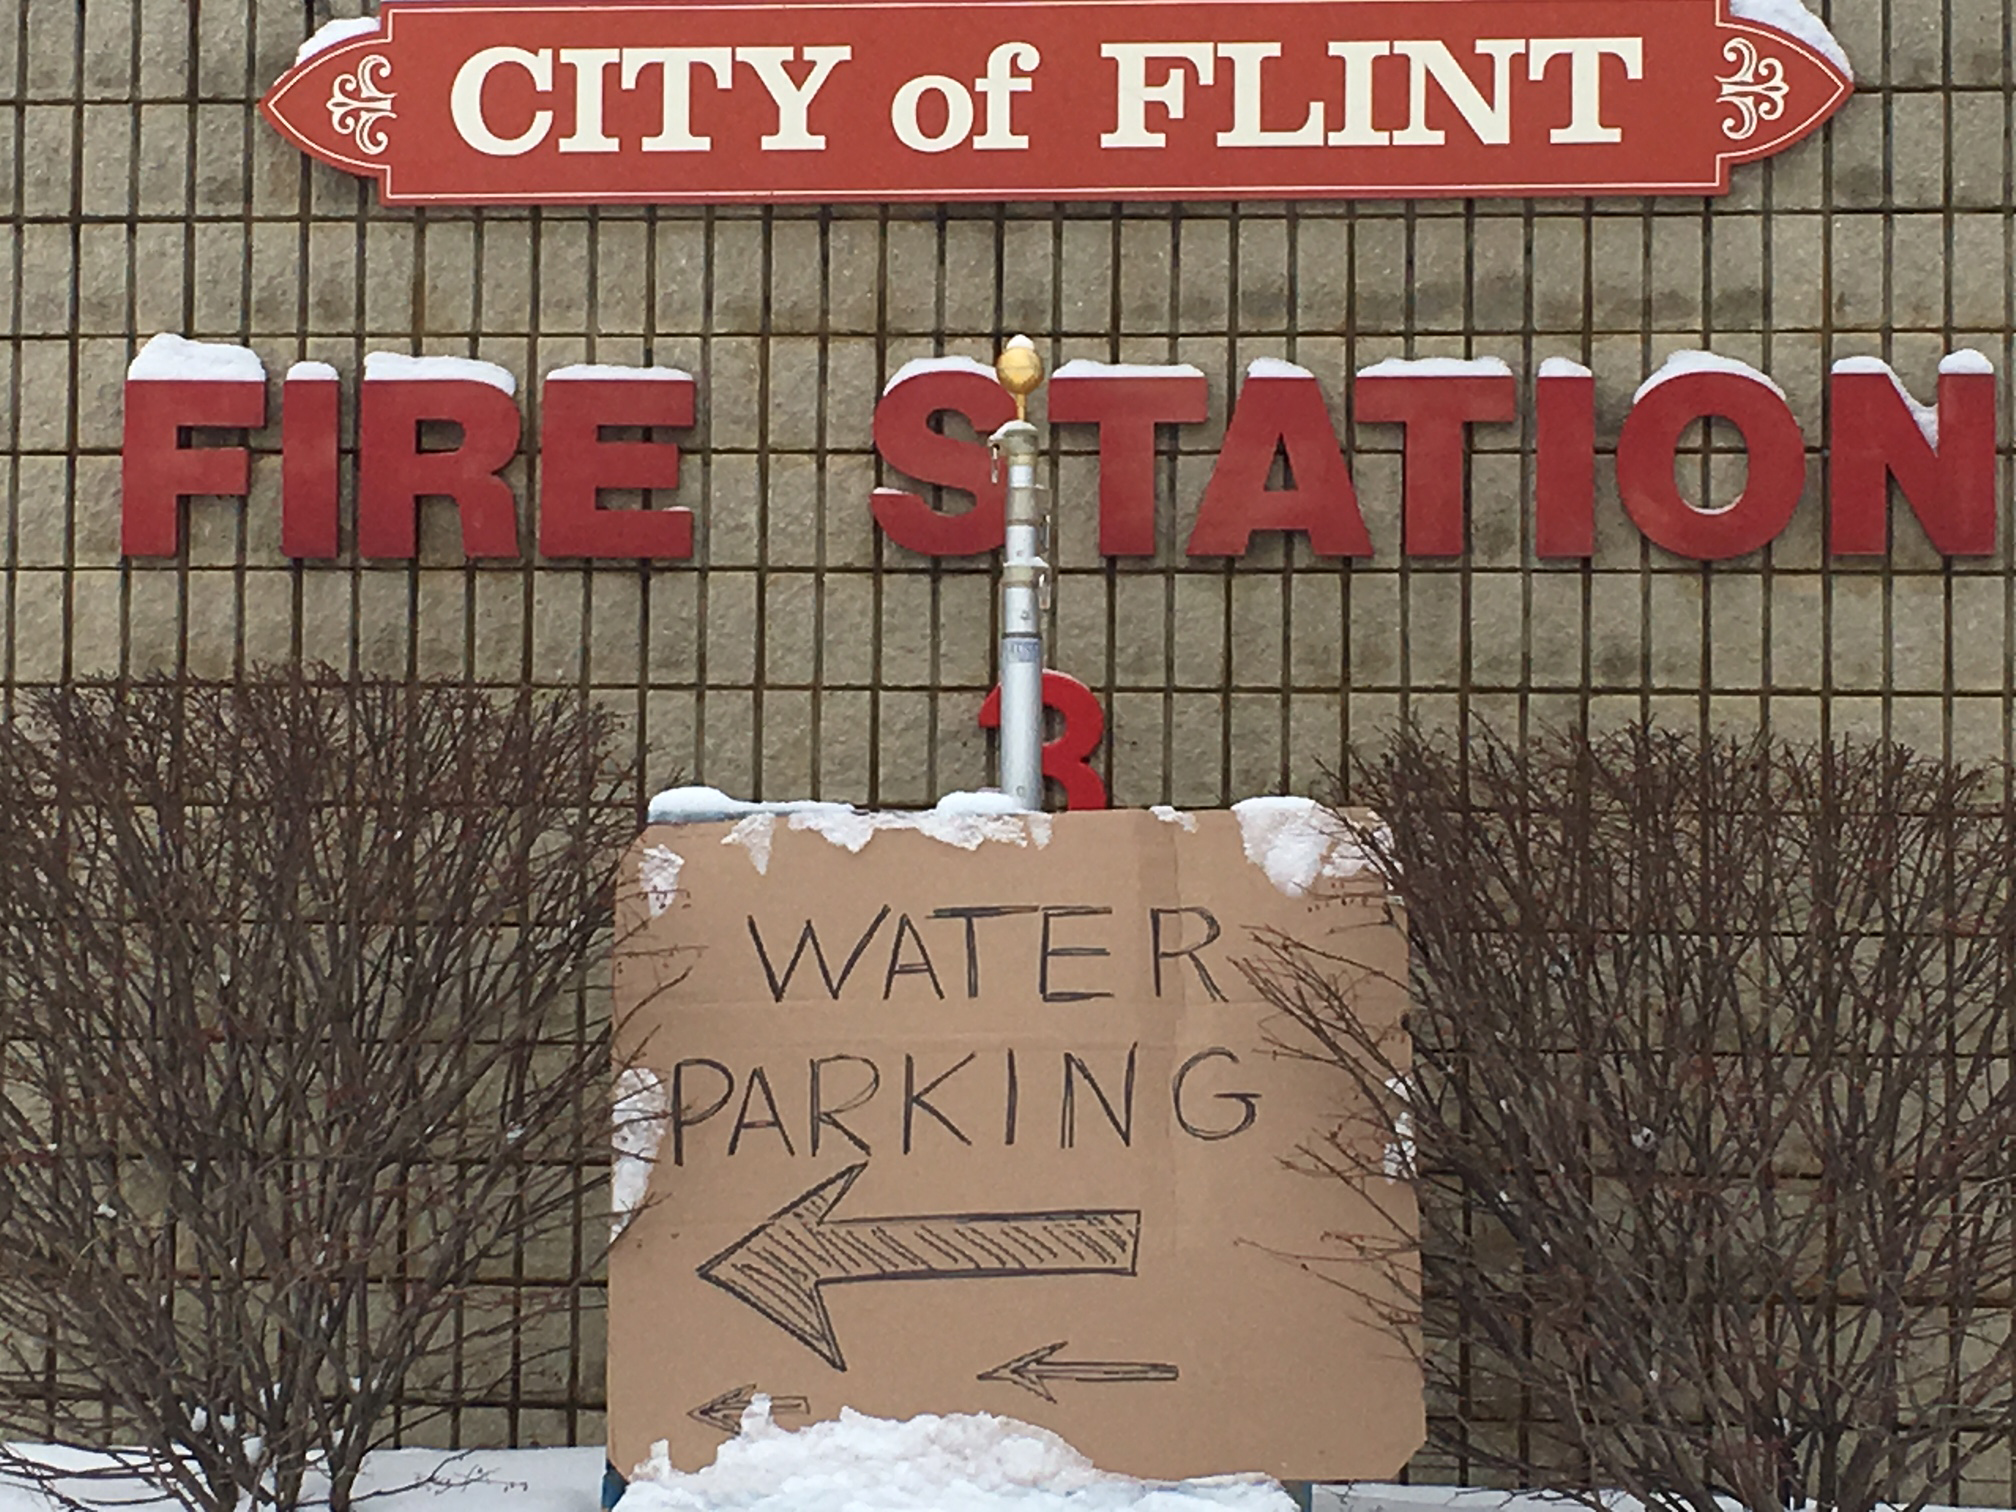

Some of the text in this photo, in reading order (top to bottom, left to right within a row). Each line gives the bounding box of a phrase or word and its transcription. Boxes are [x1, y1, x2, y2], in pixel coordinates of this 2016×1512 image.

[450, 36, 1644, 157] CITY of FLINT
[121, 368, 1996, 560] FIRE STATION
[745, 903, 1230, 1004] WATER
[670, 1040, 1263, 1167] PARKING
